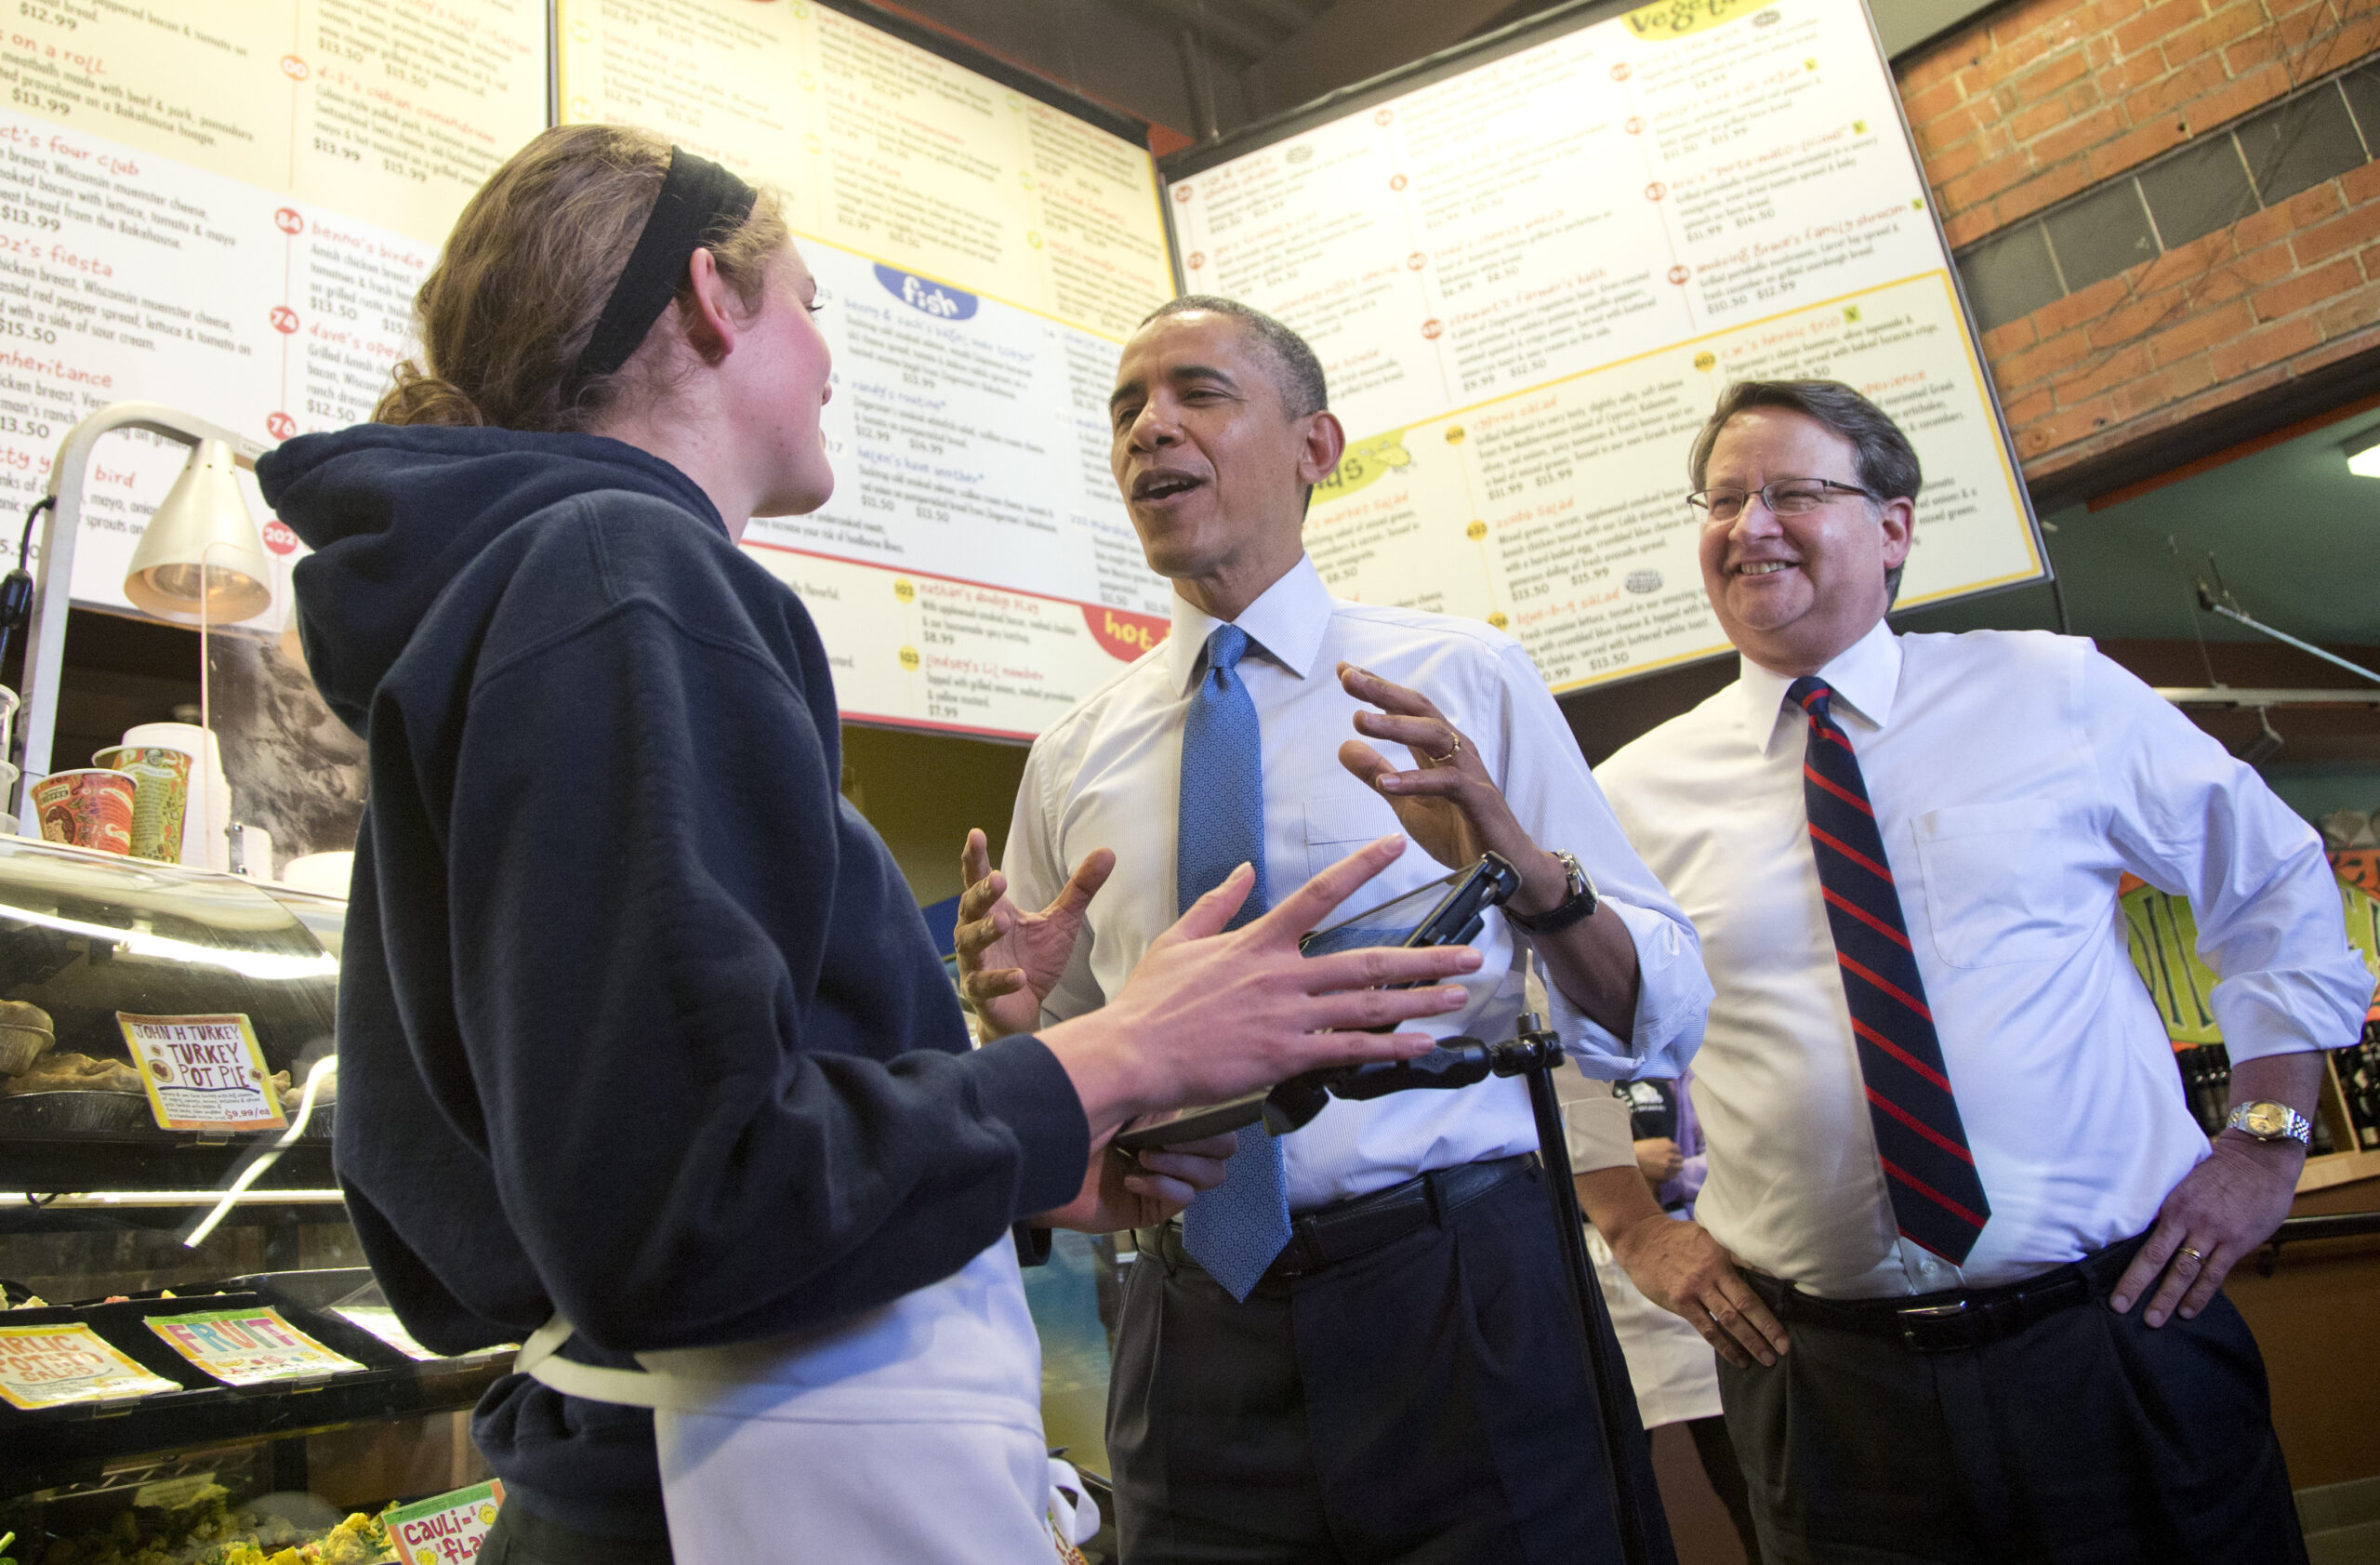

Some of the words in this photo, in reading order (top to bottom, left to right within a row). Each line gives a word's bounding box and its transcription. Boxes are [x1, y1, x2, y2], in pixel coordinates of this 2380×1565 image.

[20, 3, 78, 31] $12.99
[12, 35, 37, 53] on
[13, 88, 72, 116] $13.99
[100, 86, 125, 99] with
[48, 137, 90, 160] four
[98, 157, 140, 177] club
[55, 163, 110, 190] Wisconsin
[39, 177, 75, 199] bacon
[77, 193, 103, 207] with
[0, 206, 61, 233] $13.99
[25, 192, 61, 216] bread
[63, 204, 94, 224] from
[98, 215, 115, 232] the
[50, 245, 113, 279] fiesta
[84, 280, 139, 306] Wisconsin
[902, 275, 959, 317] fish
[33, 291, 55, 305] red
[57, 298, 98, 315] pepper
[102, 309, 141, 328] spread,
[271, 310, 296, 330] 74
[9, 306, 34, 321] with
[49, 316, 73, 330] side
[91, 326, 115, 340] sour
[120, 335, 156, 351] cream.
[310, 323, 361, 351] dave's
[269, 417, 295, 436] 76
[95, 465, 136, 489] bird
[264, 526, 295, 547] 202
[1104, 611, 1154, 651] hot
[134, 1024, 171, 1040] JOHN
[176, 1026, 187, 1041] H
[188, 1025, 239, 1041] TURKEY
[167, 1042, 239, 1065] TURKEY
[178, 1064, 214, 1087] POT
[219, 1066, 250, 1088] PIE
[165, 1318, 295, 1354] FRUIT
